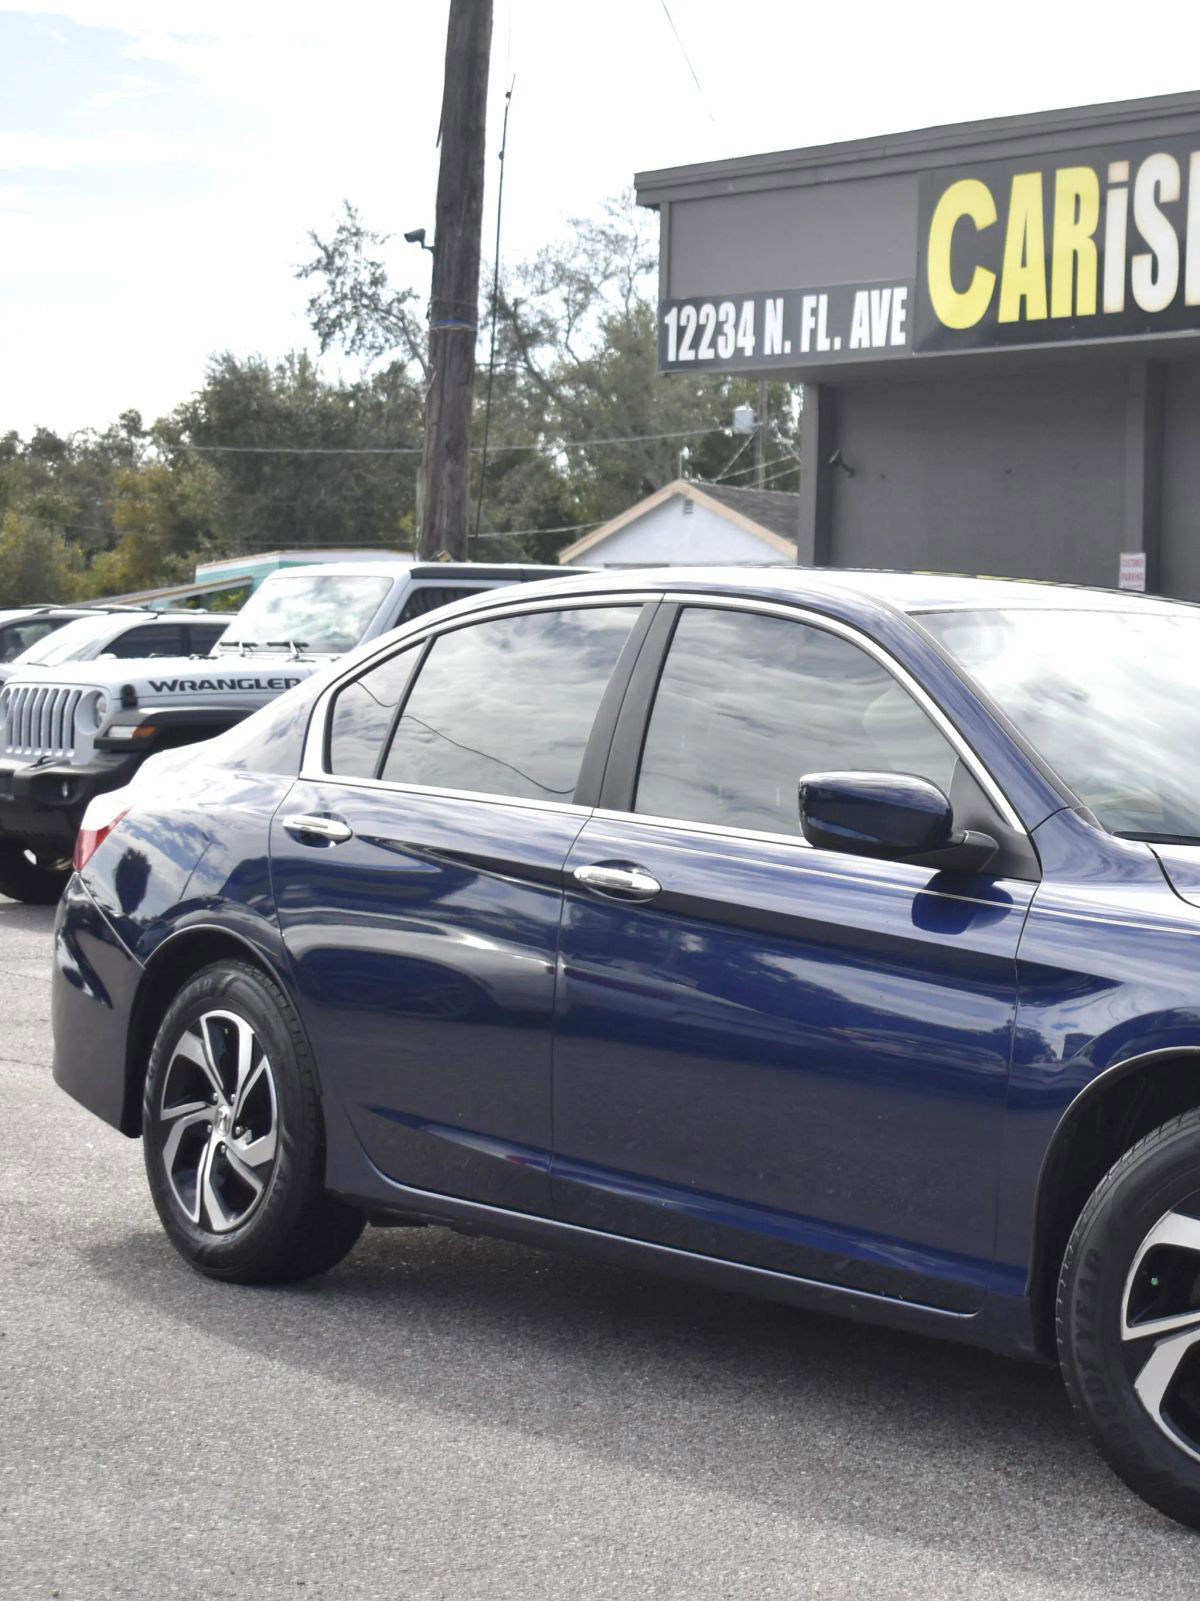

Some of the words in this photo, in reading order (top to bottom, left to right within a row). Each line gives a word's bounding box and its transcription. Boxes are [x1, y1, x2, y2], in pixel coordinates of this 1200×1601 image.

[663, 301, 756, 362] 12234
[763, 298, 792, 356] N.
[800, 293, 842, 353] FL.
[850, 286, 908, 350] AVE
[148, 678, 302, 692] WRANGLER
